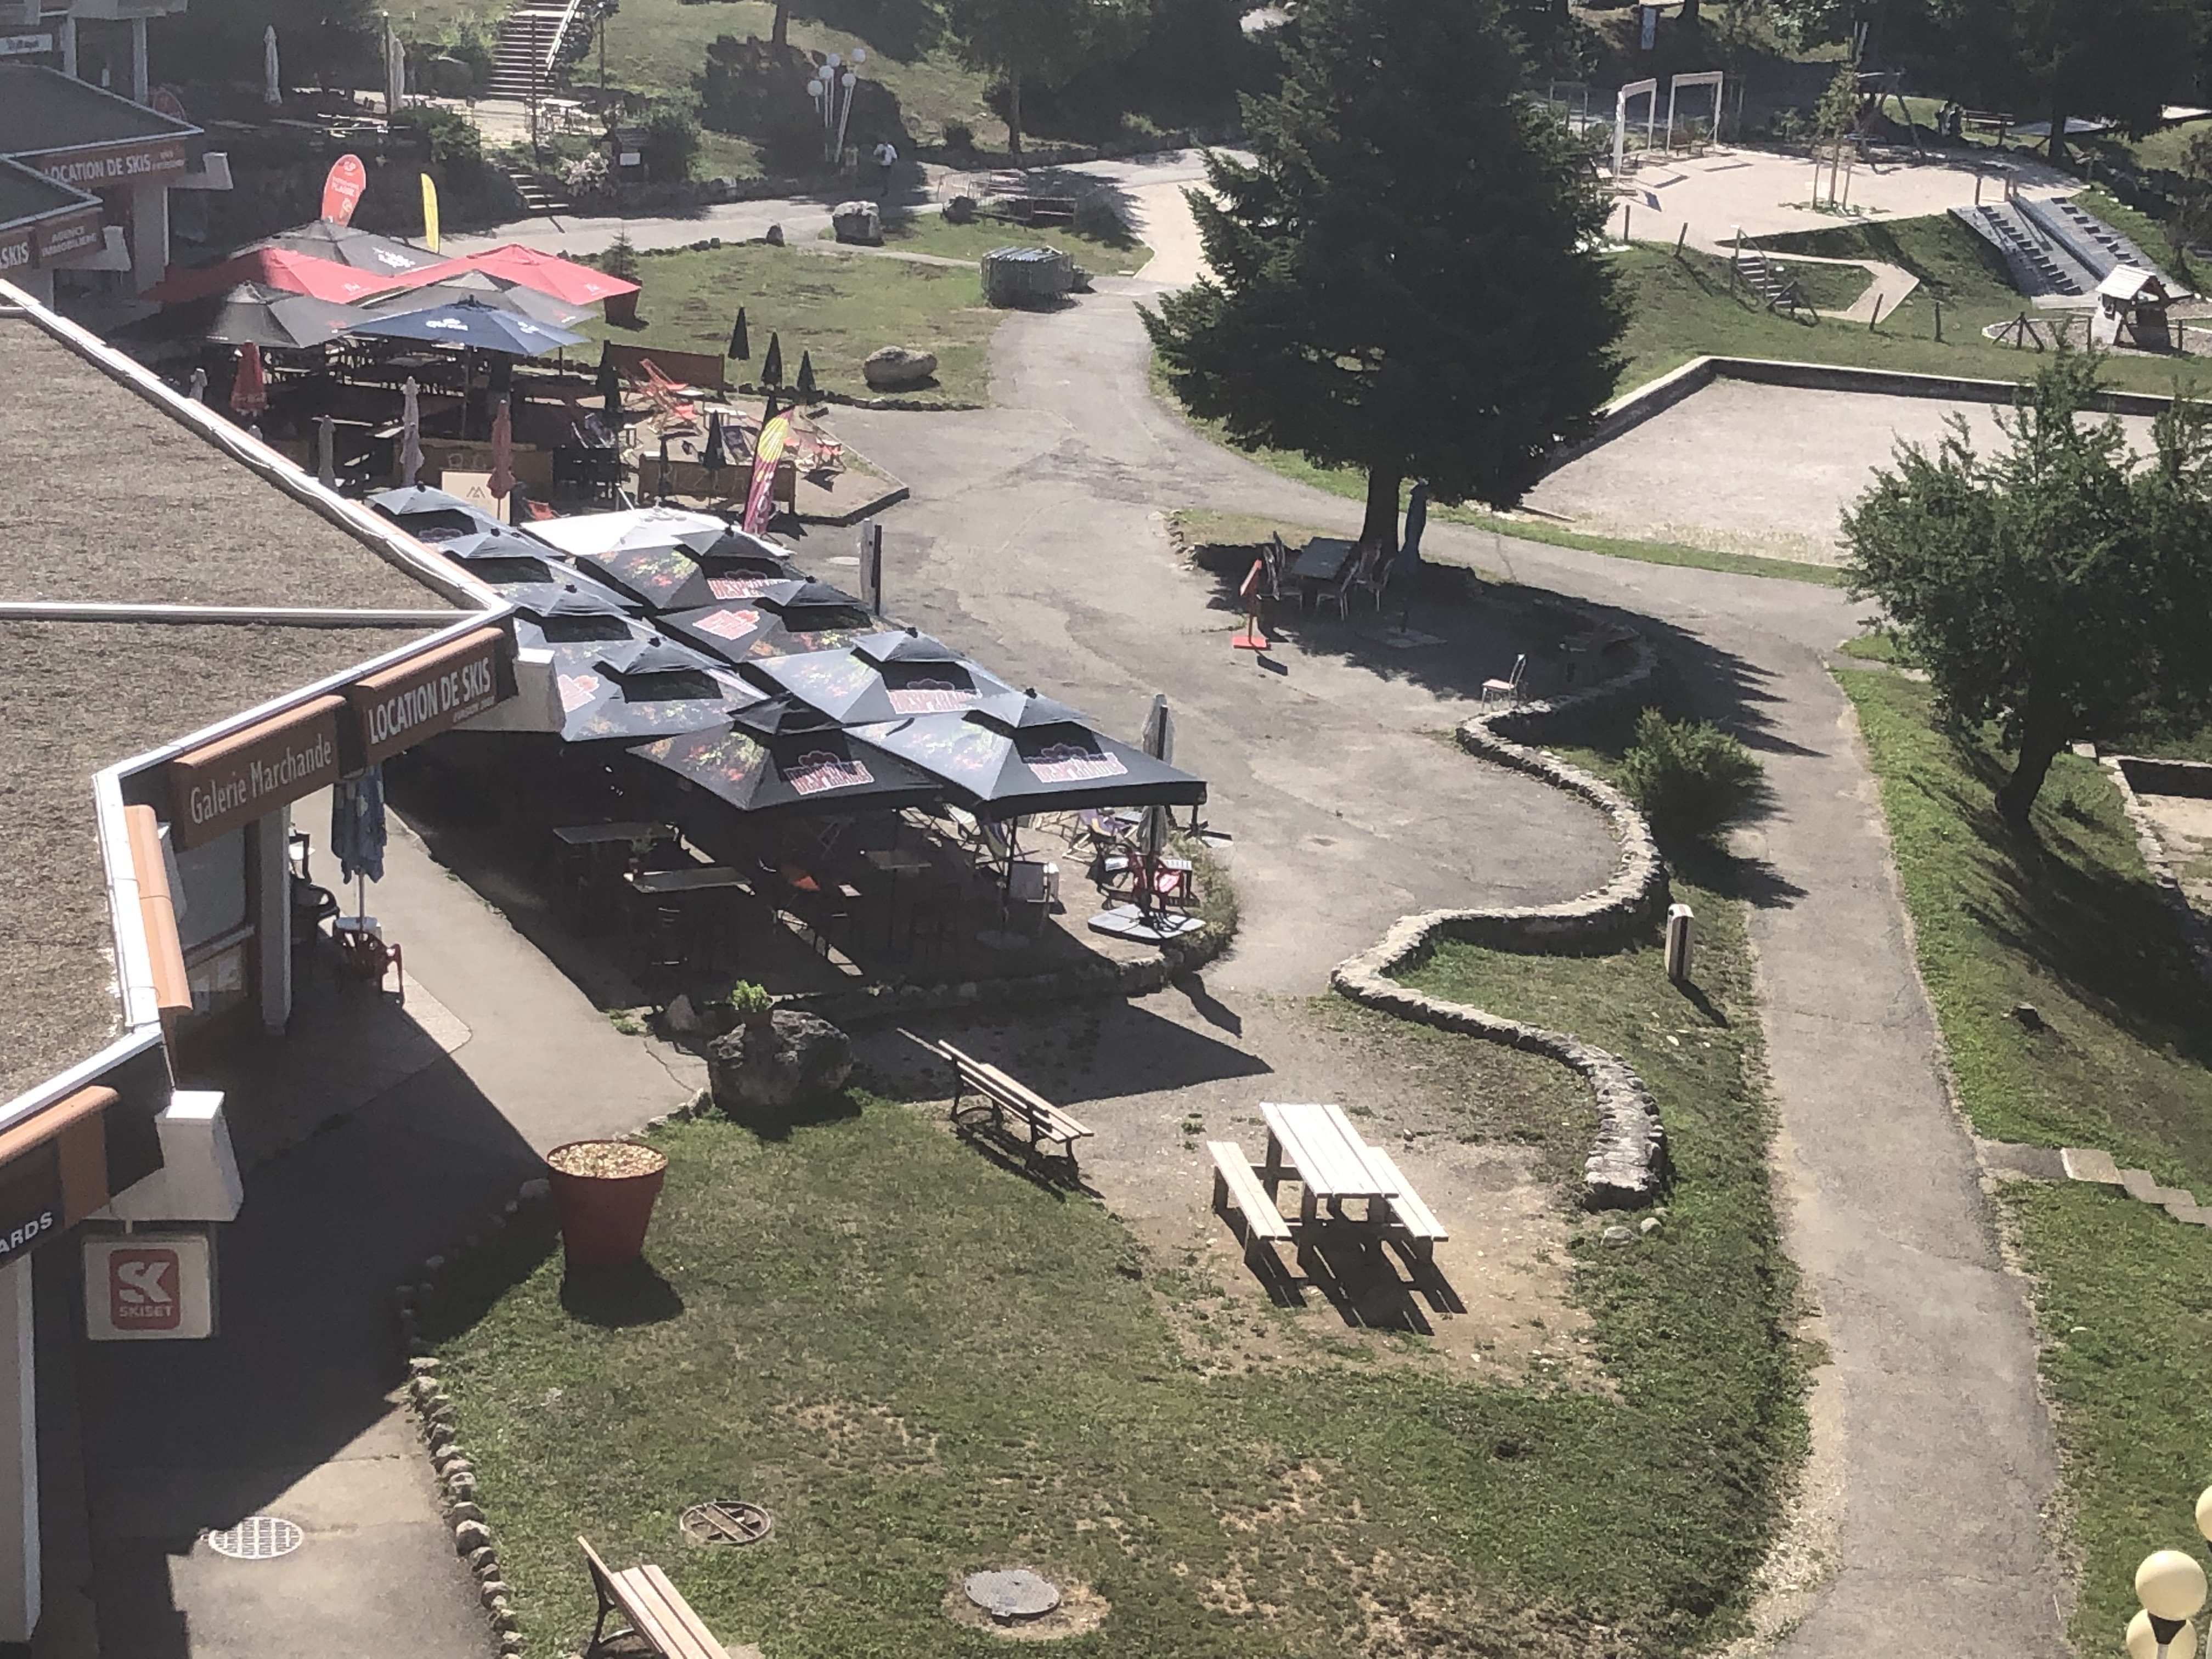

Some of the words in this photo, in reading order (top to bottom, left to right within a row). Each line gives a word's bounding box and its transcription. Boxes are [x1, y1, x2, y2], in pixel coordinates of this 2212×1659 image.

[106, 157, 123, 176] DE
[126, 153, 150, 174] SKIS
[0, 241, 30, 269] SKIS
[369, 680, 439, 744] LOCATION
[441, 672, 460, 711] DE
[462, 657, 491, 702] SKIS
[191, 771, 247, 823] Galerie
[250, 732, 331, 798] Marchande
[0, 1211, 53, 1254] ARDS
[119, 1305, 172, 1317] SKISET
